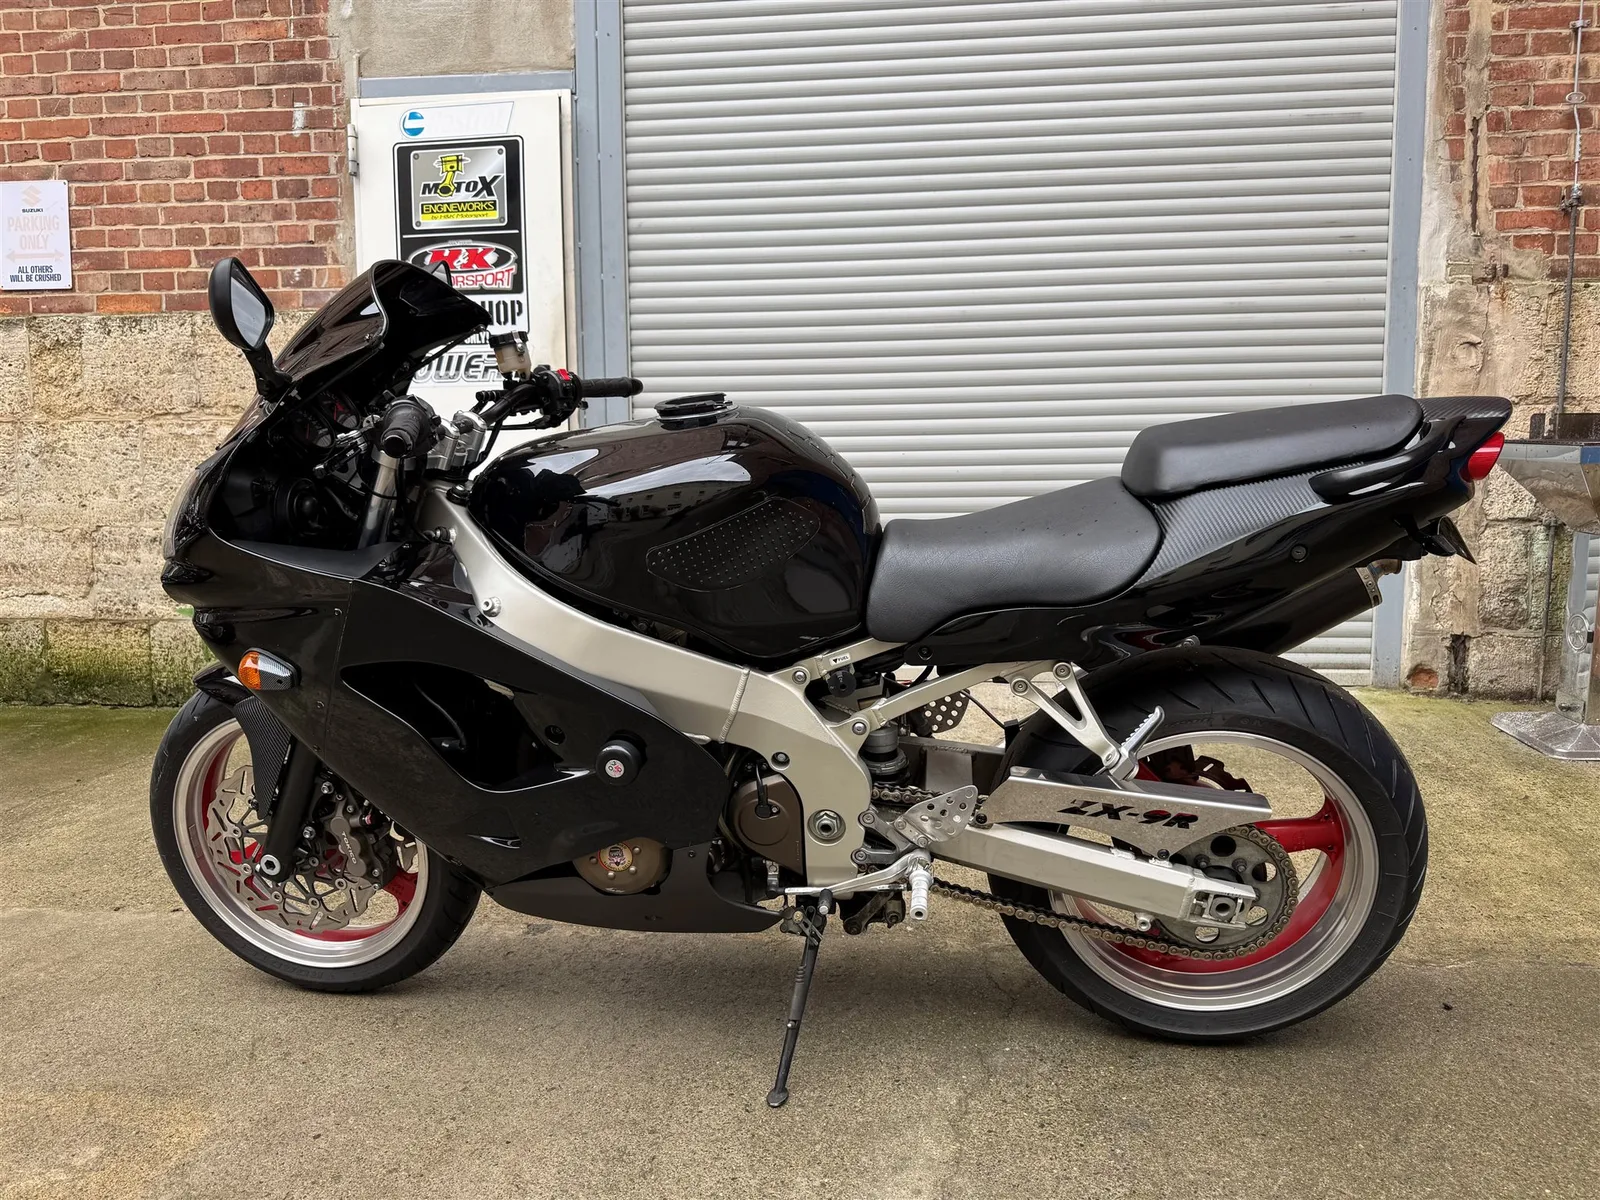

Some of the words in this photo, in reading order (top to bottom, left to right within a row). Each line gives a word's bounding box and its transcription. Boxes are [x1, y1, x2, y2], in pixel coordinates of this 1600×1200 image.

[423, 201, 495, 214] ENGINEWORKS
[7, 215, 60, 232] PARKING
[19, 233, 50, 250] ONLY
[10, 274, 24, 283] WILL
[25, 274, 33, 282] BE
[35, 273, 62, 282] CRUSHED
[18, 265, 29, 274] ALL
[30, 265, 53, 274] OTHERS
[1057, 799, 1199, 829] ZX-9R
[341, 831, 357, 864] TOKICO
